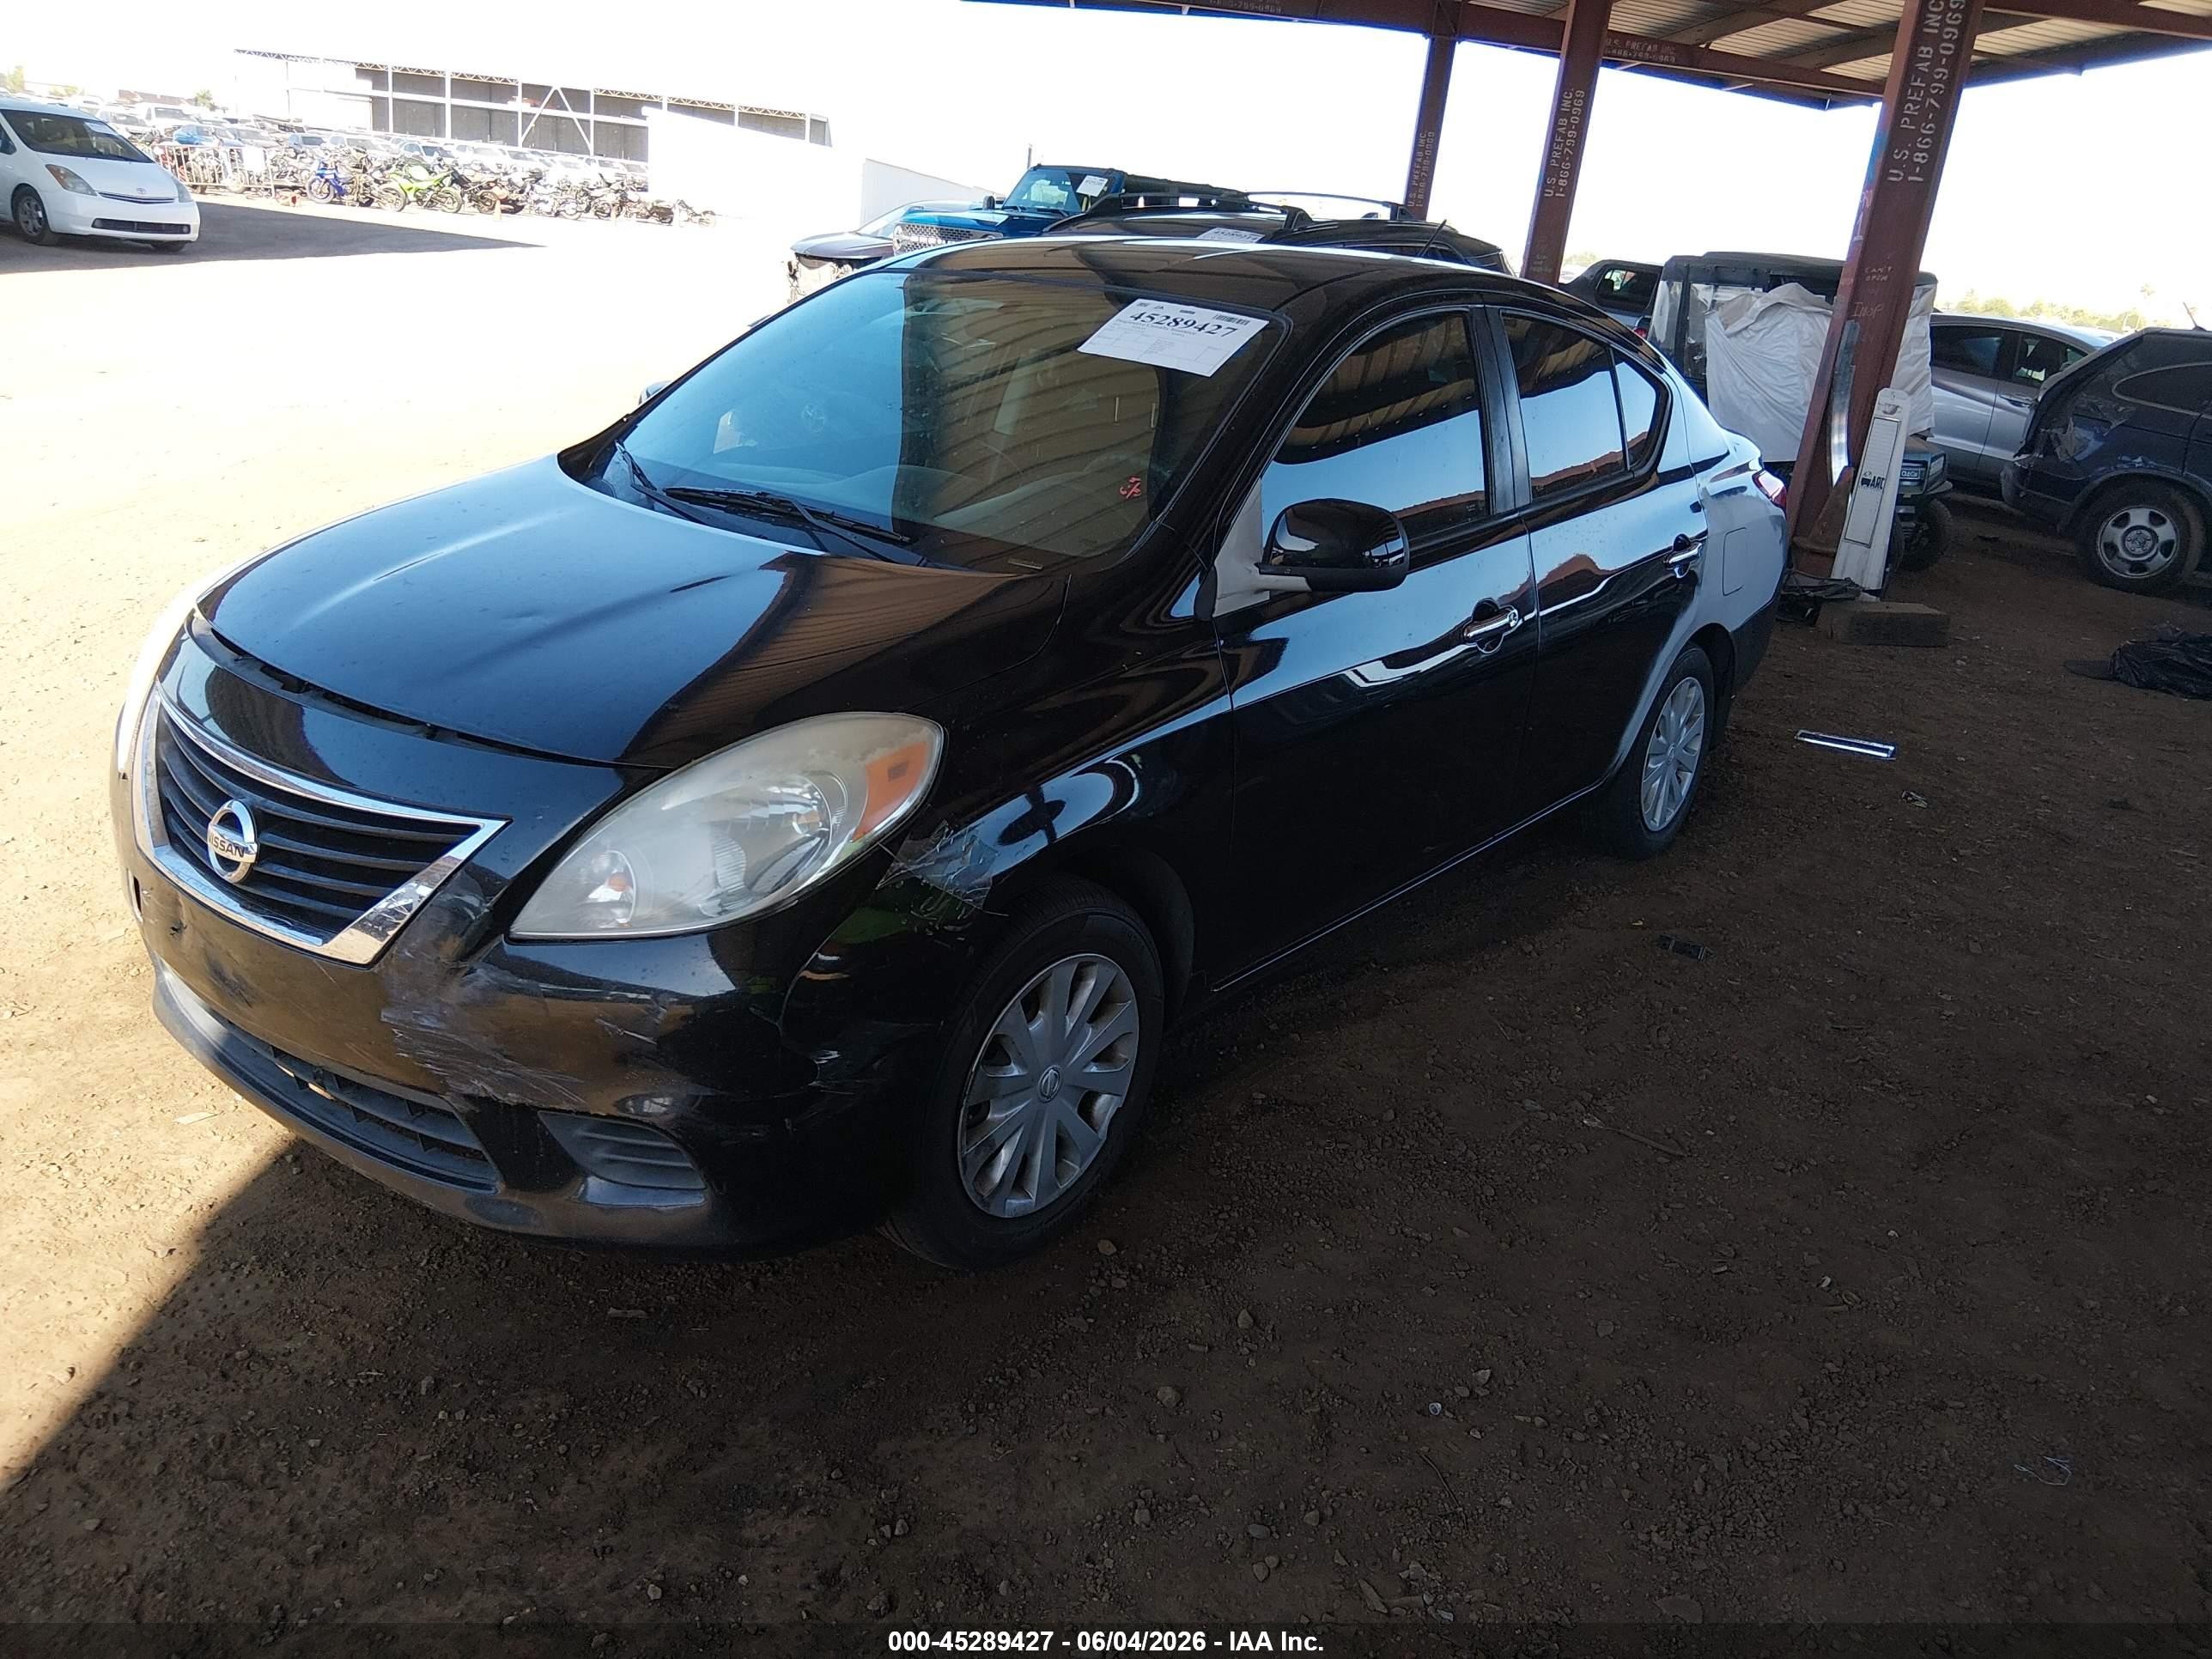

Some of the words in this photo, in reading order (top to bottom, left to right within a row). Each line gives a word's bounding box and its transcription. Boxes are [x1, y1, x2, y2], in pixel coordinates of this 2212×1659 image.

[1550, 117, 1568, 167] PREFAB
[1561, 88, 1574, 112] INC.
[1887, 143, 1911, 182] U.S.
[1900, 46, 1933, 129] PREFAB
[1907, 0, 1966, 182] 1-866-799-0969
[1555, 89, 1585, 198] 1-866-799-0969
[1130, 312, 1238, 337] 45289427
[208, 830, 246, 858] NISSAN
